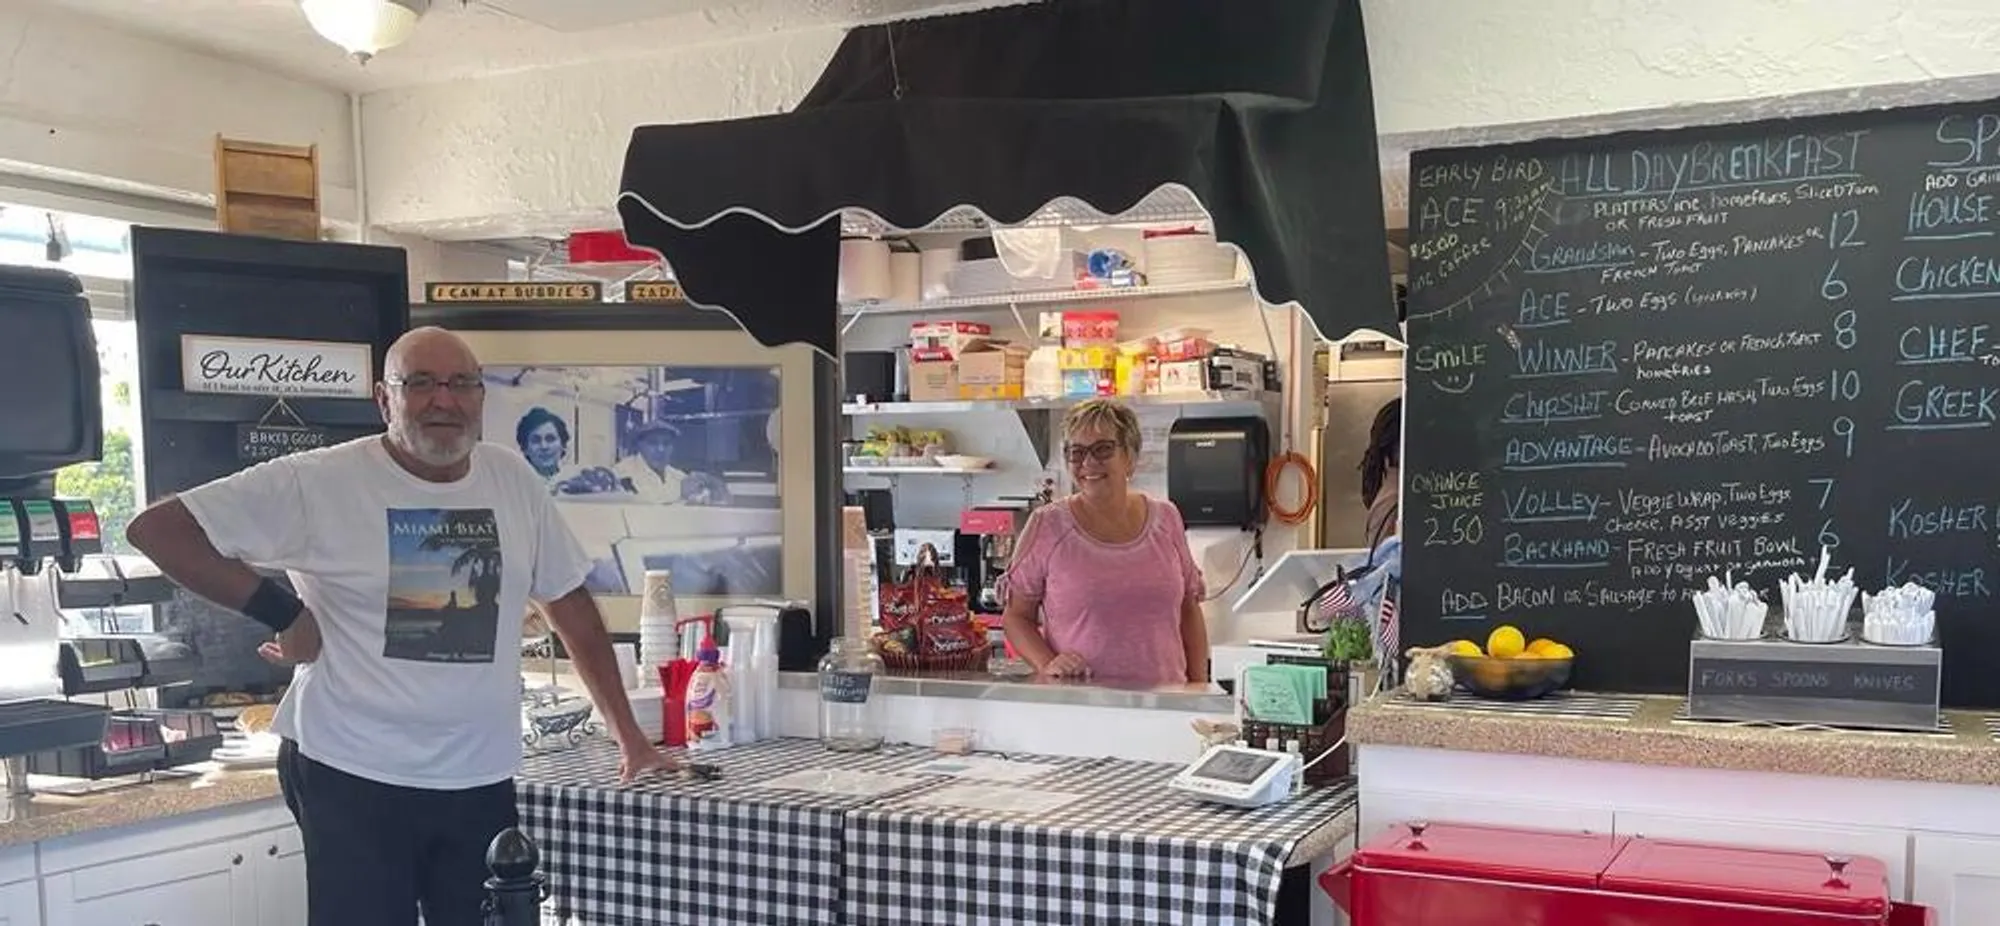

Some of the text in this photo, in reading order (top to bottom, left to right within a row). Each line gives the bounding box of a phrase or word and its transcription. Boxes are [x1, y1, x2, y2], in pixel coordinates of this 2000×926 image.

[1927, 114, 2000, 166] SP
[1419, 157, 1543, 190] EARLY BIRD
[1562, 152, 1620, 194] ALL
[1925, 174, 1957, 191] ADD
[1420, 197, 1485, 230] ACE
[1907, 192, 1993, 232] HOUSE
[1733, 235, 1804, 257] PANCAKES
[1828, 209, 1866, 250] 12
[1519, 287, 1571, 324] ACE
[1821, 259, 1848, 300] 6
[1515, 339, 1618, 374] WINNER
[1633, 340, 1716, 363] PANCAKES
[1834, 310, 1857, 349] 8
[1900, 324, 1991, 359] CHEF
[200, 350, 357, 384] Our Kitchen
[1831, 369, 1861, 401] 10
[1896, 380, 1999, 422] GREEK
[250, 432, 288, 444] BAKED
[1505, 434, 1633, 465] ADVANTAGE
[1833, 415, 1856, 457] 9
[1431, 491, 1483, 510] JUICE
[1808, 478, 1833, 510] 7
[393, 522, 450, 536] MIAMI
[1888, 499, 1988, 538] KOSHER
[1504, 518, 1841, 565] BACKHAND FRESH FRUIT BOWL 6
[1441, 588, 1489, 615] ADD
[1497, 582, 1556, 611] BACON
[1701, 670, 1915, 691] FORKS SPOONS KNIVES
